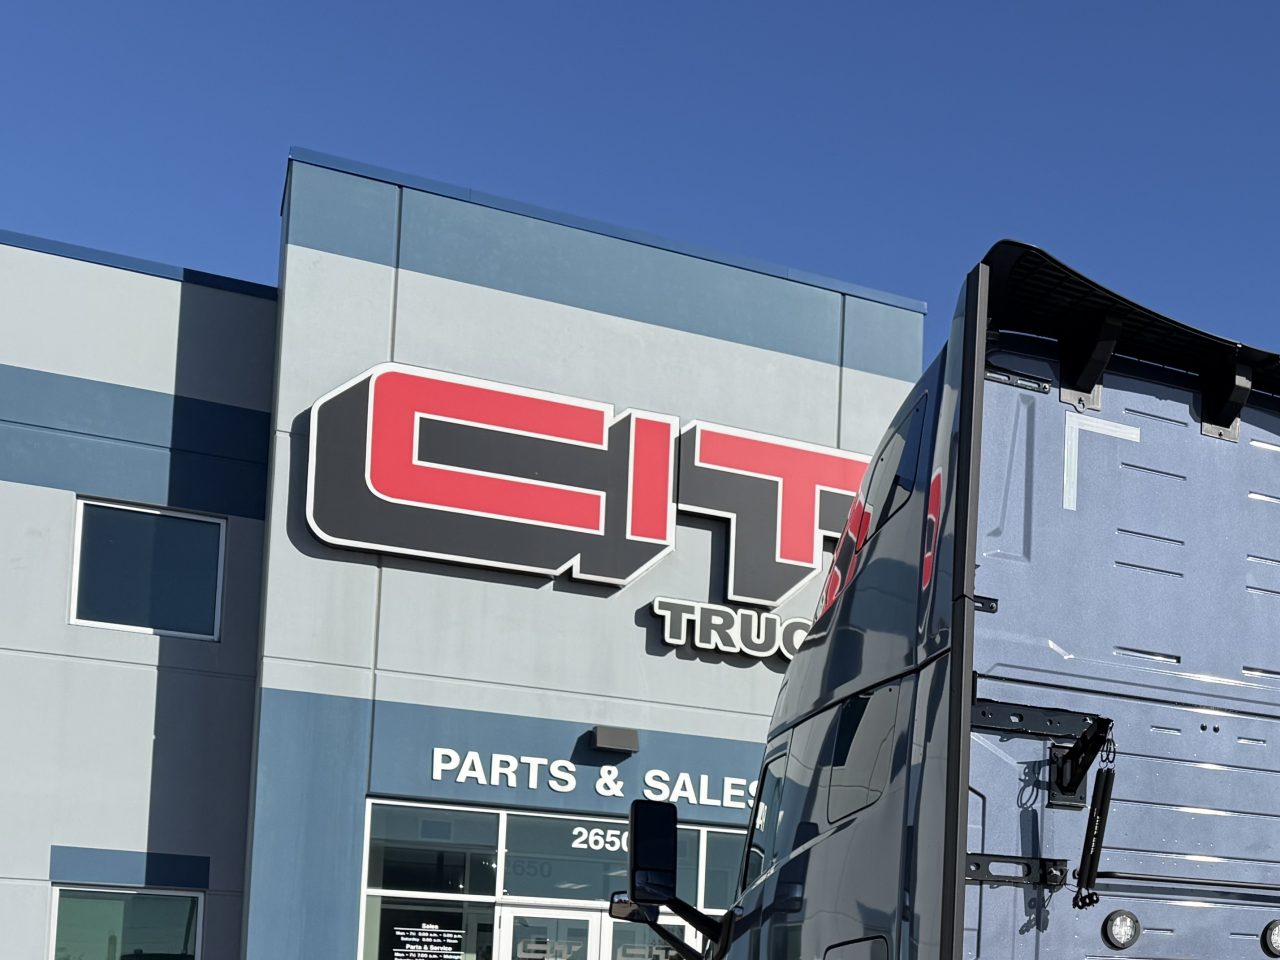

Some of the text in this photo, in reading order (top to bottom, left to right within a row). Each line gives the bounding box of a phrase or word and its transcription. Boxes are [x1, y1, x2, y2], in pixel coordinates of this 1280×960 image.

[308, 362, 872, 603] CIT
[431, 746, 577, 793] PARTS
[597, 764, 625, 798] &
